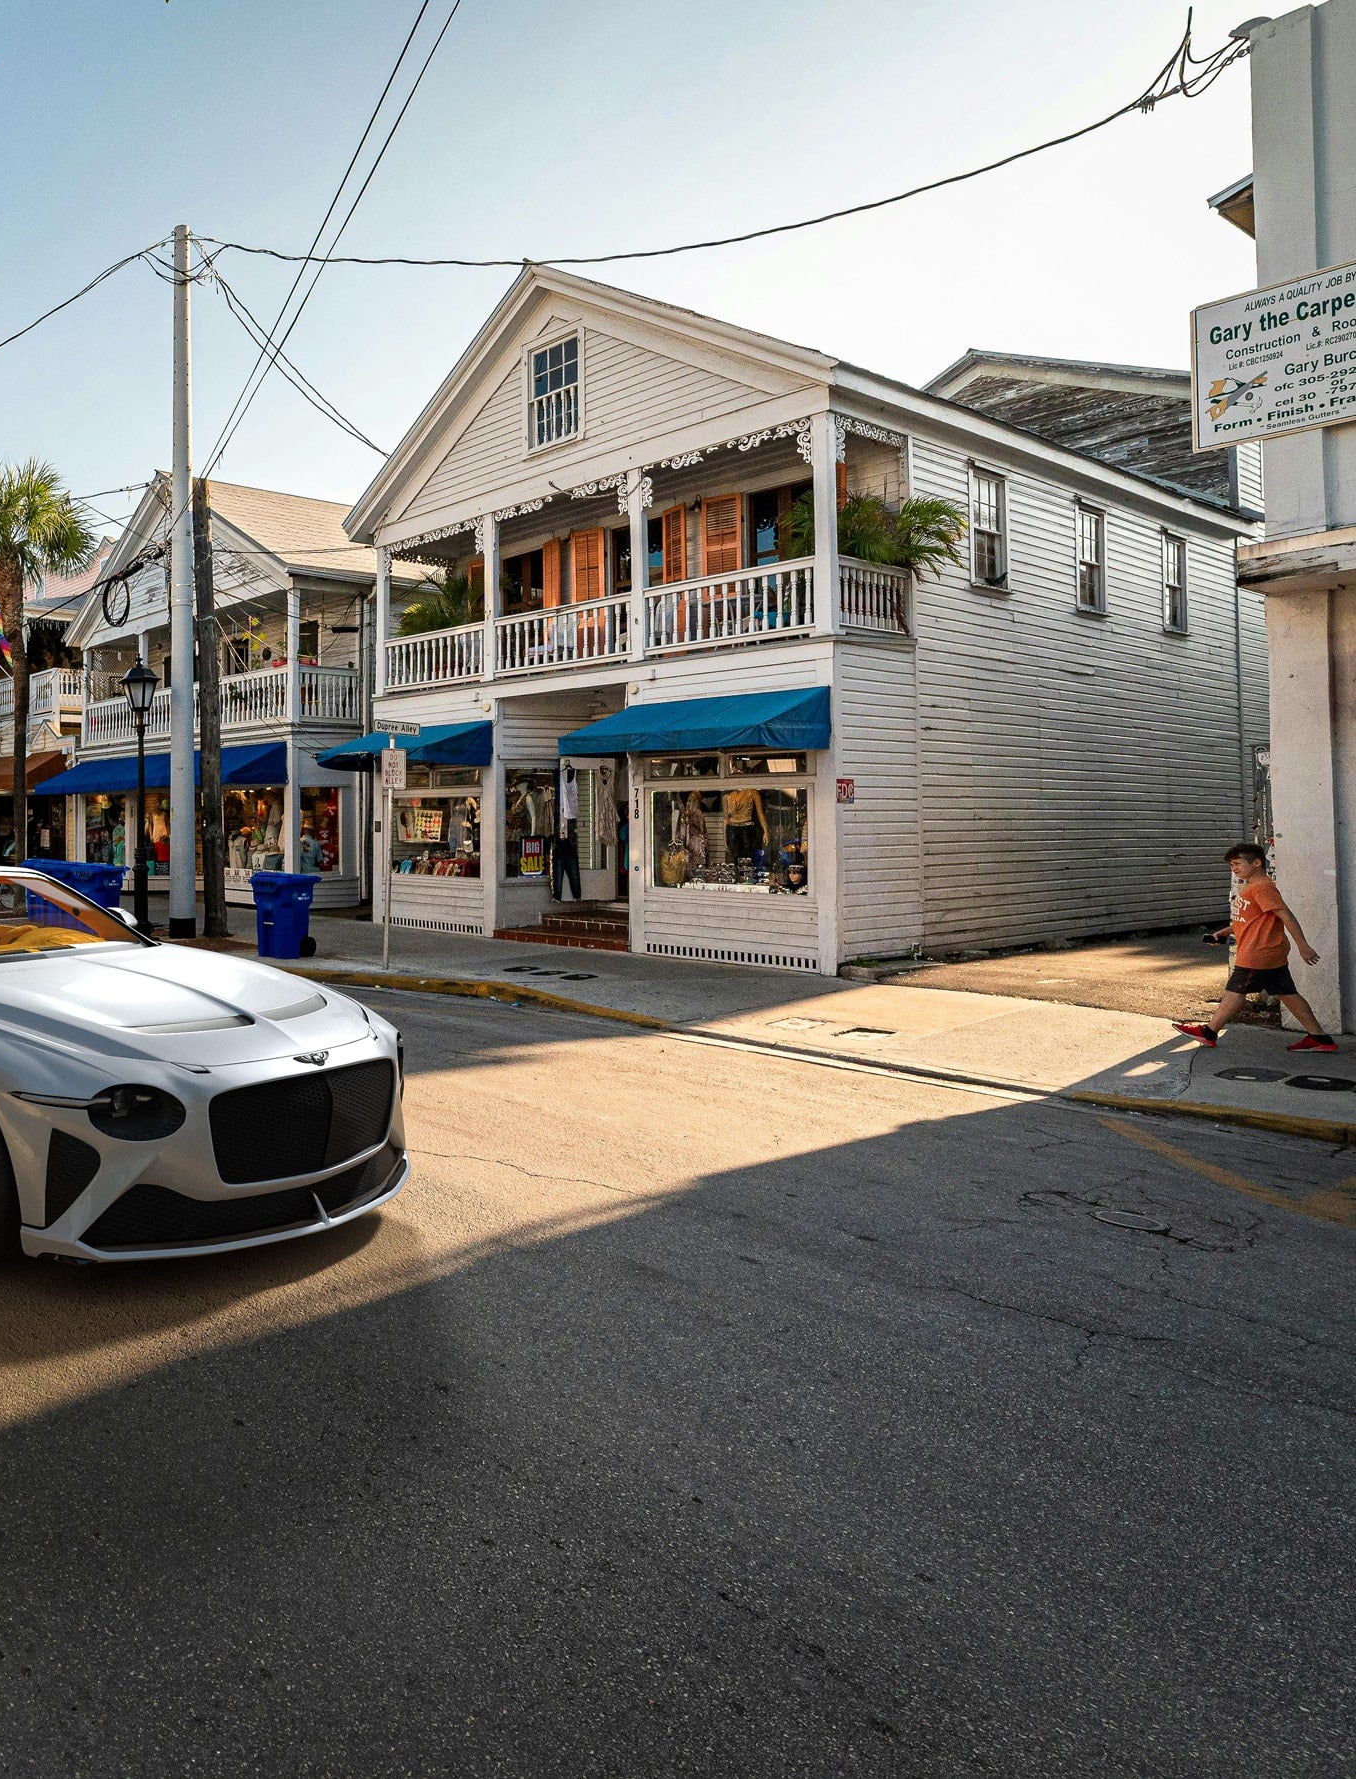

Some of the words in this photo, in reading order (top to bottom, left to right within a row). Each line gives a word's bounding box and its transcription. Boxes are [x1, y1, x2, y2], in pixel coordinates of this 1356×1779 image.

[1244, 295, 1276, 312] ALWAYS
[1279, 293, 1285, 303] A
[1286, 281, 1323, 300] QUALITY
[1325, 275, 1343, 289] JOB
[1345, 271, 1356, 283] BY
[1209, 321, 1253, 345] Gary
[1259, 311, 1290, 332] the
[1296, 292, 1356, 321] Carpe
[1225, 333, 1301, 360] Construction
[1312, 325, 1321, 337] &
[1332, 318, 1356, 332] Roo
[1284, 359, 1319, 376] Gary
[1324, 350, 1356, 367] Burc
[1274, 382, 1294, 392] ofc
[1298, 366, 1356, 386] 305-292
[1331, 378, 1345, 386] or
[1275, 396, 1294, 407] cel
[1214, 418, 1253, 433] Form
[1267, 403, 1314, 421] Finish
[1308, 409, 1340, 421] Gutters
[376, 721, 399, 731] Dupree
[401, 725, 417, 734] Alley
[389, 753, 398, 761] DO
[384, 777, 403, 785] ALLEY
[525, 842, 540, 853] BIG
[520, 855, 544, 872] SALE
